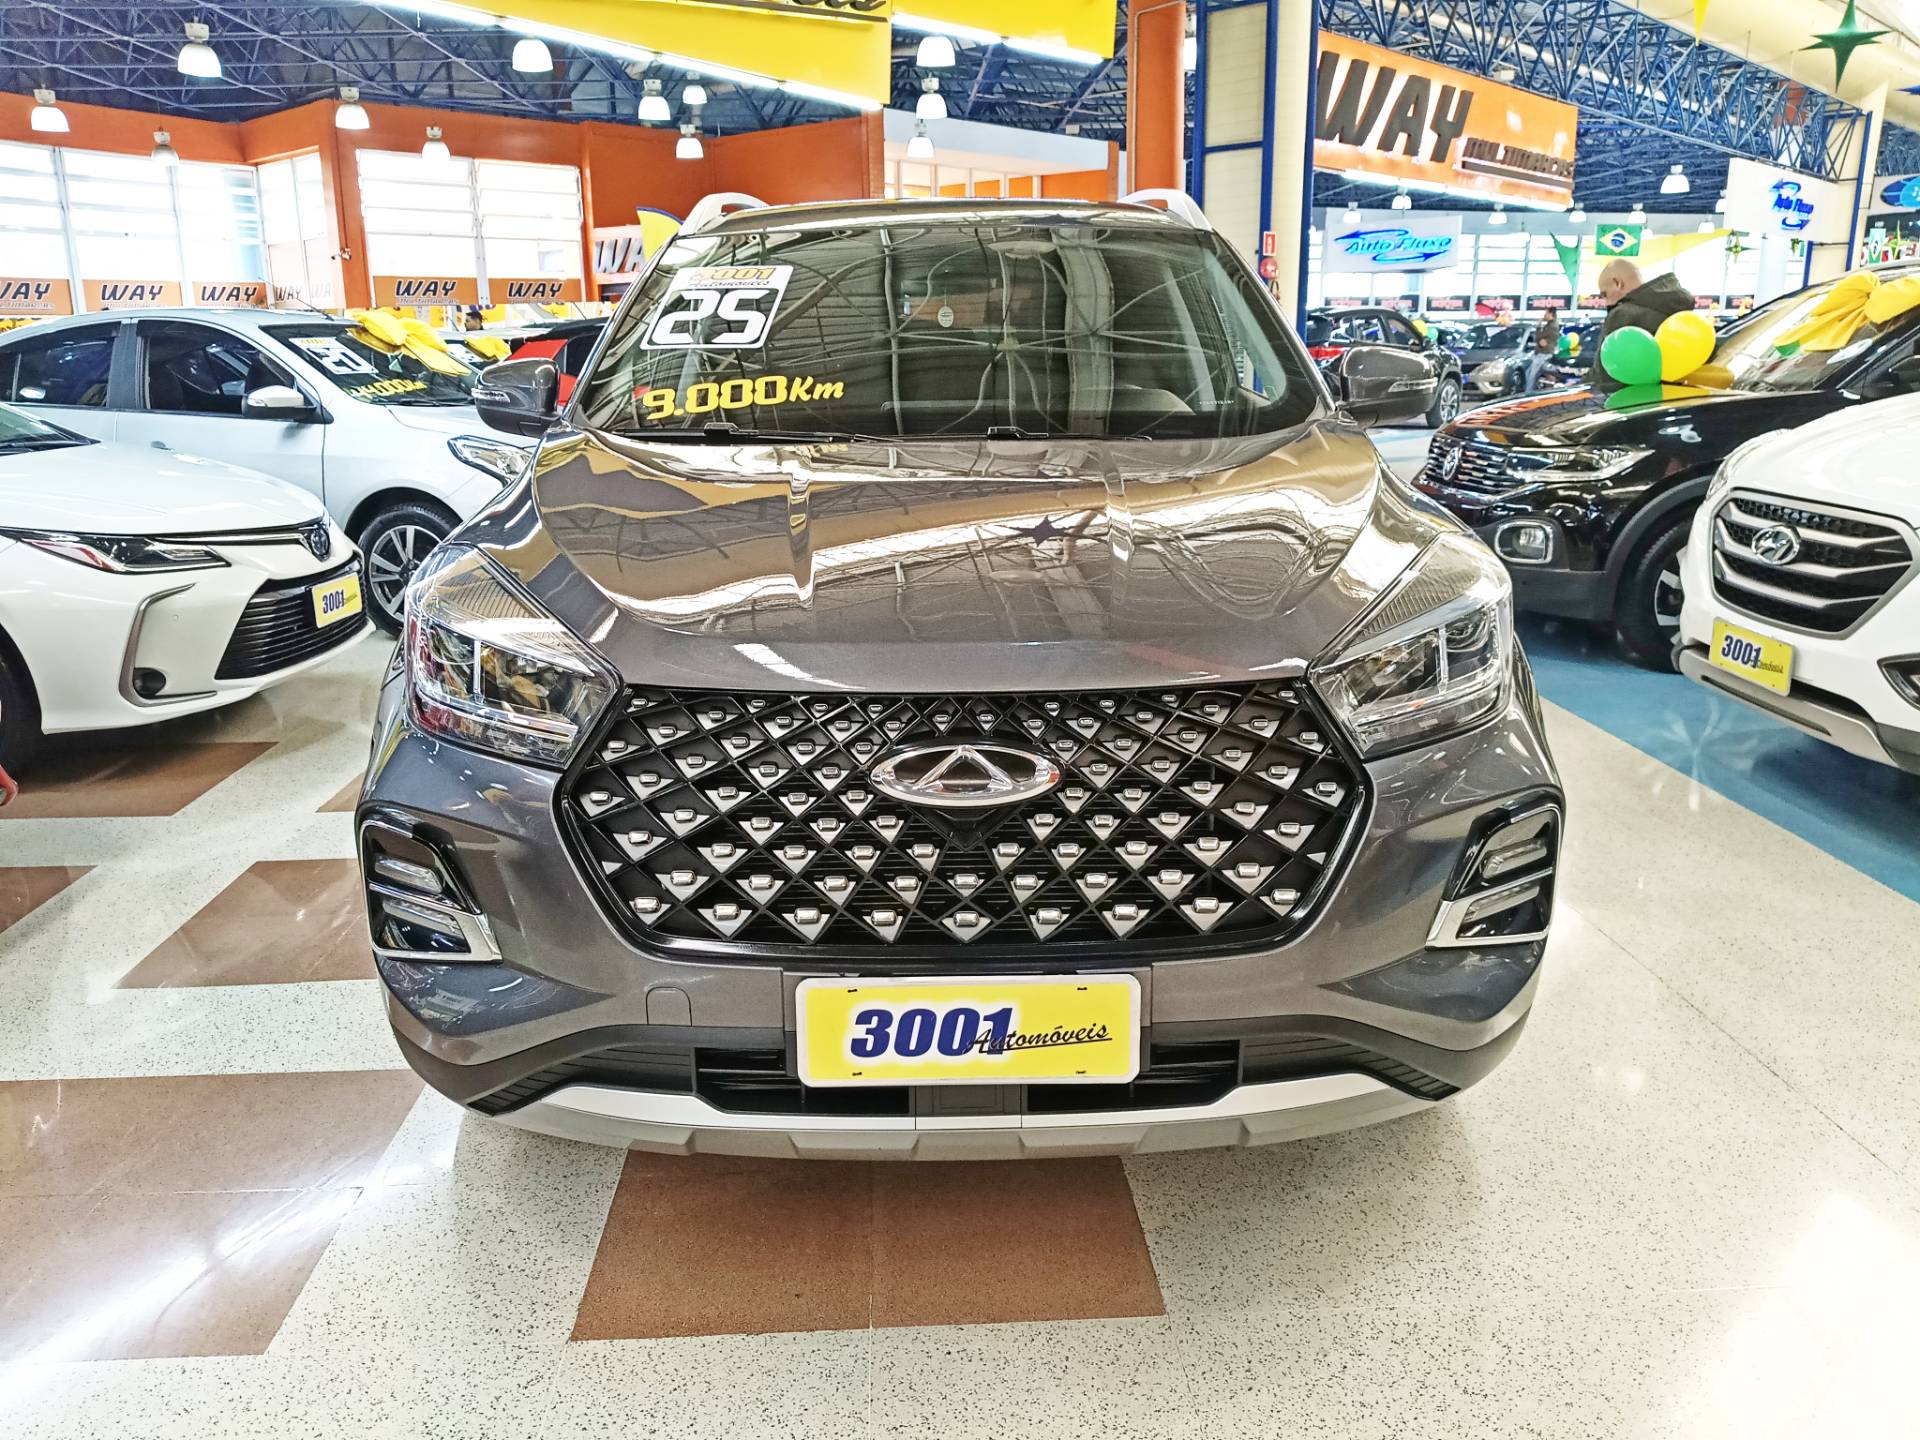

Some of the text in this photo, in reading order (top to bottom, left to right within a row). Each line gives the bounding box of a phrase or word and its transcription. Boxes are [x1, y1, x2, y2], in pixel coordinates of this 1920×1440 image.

[1315, 50, 1474, 163] WAY
[595, 237, 644, 273] WA
[1344, 237, 1452, 252] Auto Fluxo
[102, 284, 164, 301] WAY
[201, 285, 257, 302] WAY
[395, 280, 457, 297] WAY
[508, 282, 563, 298] WAY
[651, 289, 770, 344] 25
[322, 589, 345, 614] 3001
[1721, 634, 1762, 669] 3001
[850, 1007, 1112, 1057] 3001 Automóveis
